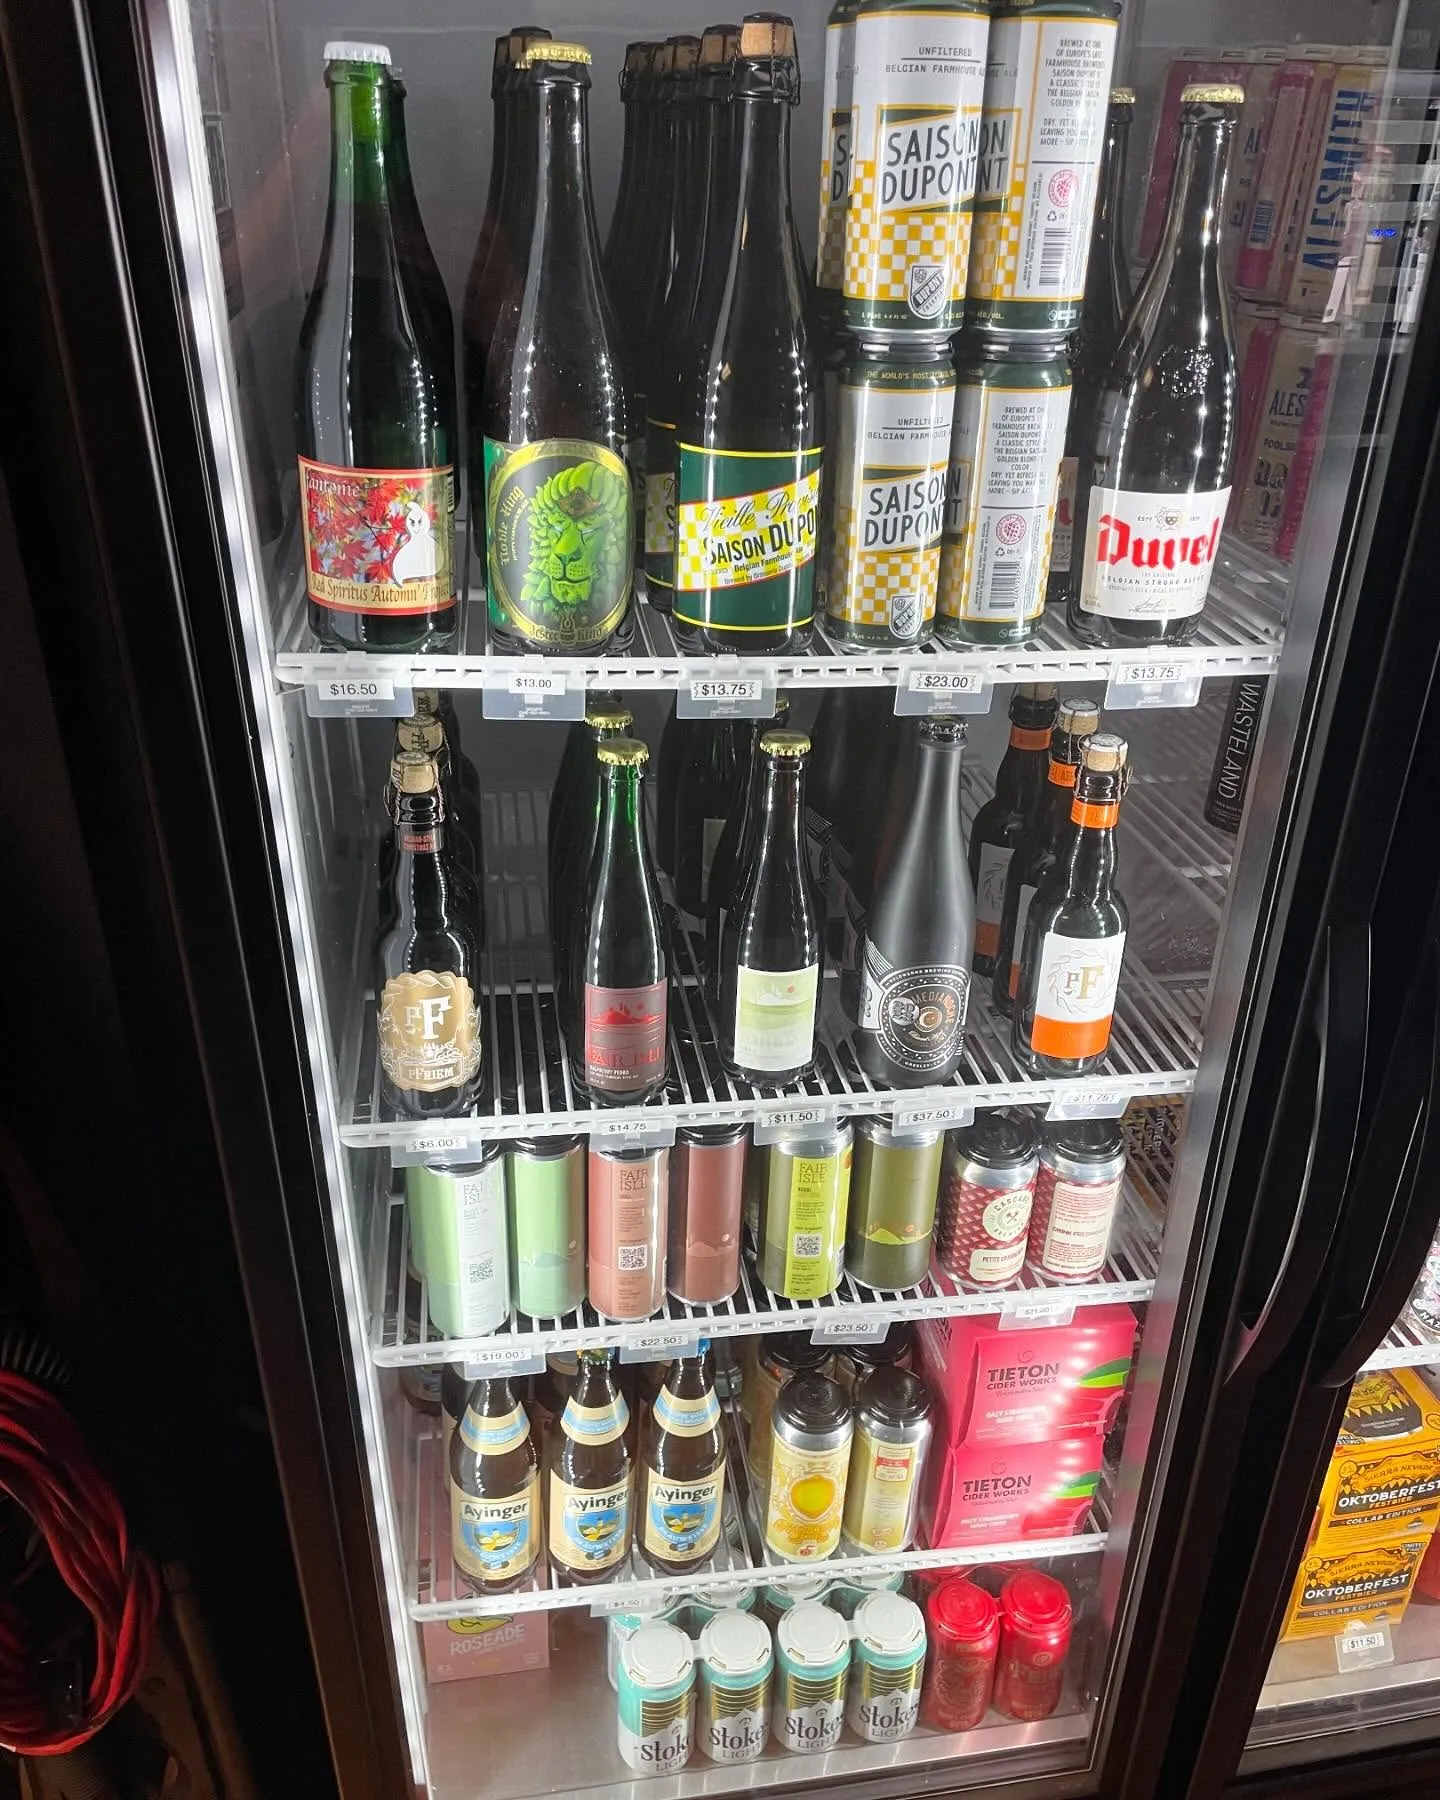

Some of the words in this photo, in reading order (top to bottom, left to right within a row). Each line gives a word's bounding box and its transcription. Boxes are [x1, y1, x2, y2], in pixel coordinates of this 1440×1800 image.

[918, 46, 973, 57] UNFILTERED
[885, 64, 927, 74] BELGIAN
[886, 118, 980, 168] SAISON
[881, 155, 977, 205] DUPONT
[867, 470, 948, 517] SAISON
[702, 534, 767, 566] SAISON
[1096, 513, 1221, 570] Duvel
[327, 579, 369, 602] Spiritus
[924, 675, 968, 688] $23.00
[1130, 667, 1175, 680] $13.75
[330, 682, 378, 696] $16.50
[701, 683, 747, 697] $13.75
[1217, 683, 1261, 799] WASTELAND
[773, 1112, 813, 1124] $11.50
[912, 1110, 950, 1122] $37.50
[608, 1123, 648, 1133] $14.75
[833, 1323, 869, 1333] $23.50
[640, 1337, 677, 1347] $22.50
[988, 1363, 1061, 1382] TIETON
[986, 1381, 1016, 1391] CIDER
[1019, 1376, 1057, 1387] WORKS
[963, 1475, 1032, 1494] TIETON
[567, 1489, 629, 1511] Ayinger
[655, 1485, 716, 1502] Ayinger
[962, 1492, 990, 1501] CIDER
[993, 1488, 1029, 1498] WORKS
[1338, 1481, 1440, 1508] OKTOBERFEST
[463, 1501, 527, 1520] Ayinger
[1346, 1514, 1384, 1526] COLLAB
[1385, 1507, 1422, 1519] EDITION
[1329, 1563, 1364, 1577] SIERRA
[1305, 1574, 1409, 1600] OKTOBERFEST
[1313, 1606, 1350, 1617] COLLAB
[1351, 1600, 1388, 1612] EDITION
[450, 1623, 526, 1657] ROSEADE
[1350, 1636, 1376, 1650] $11.50
